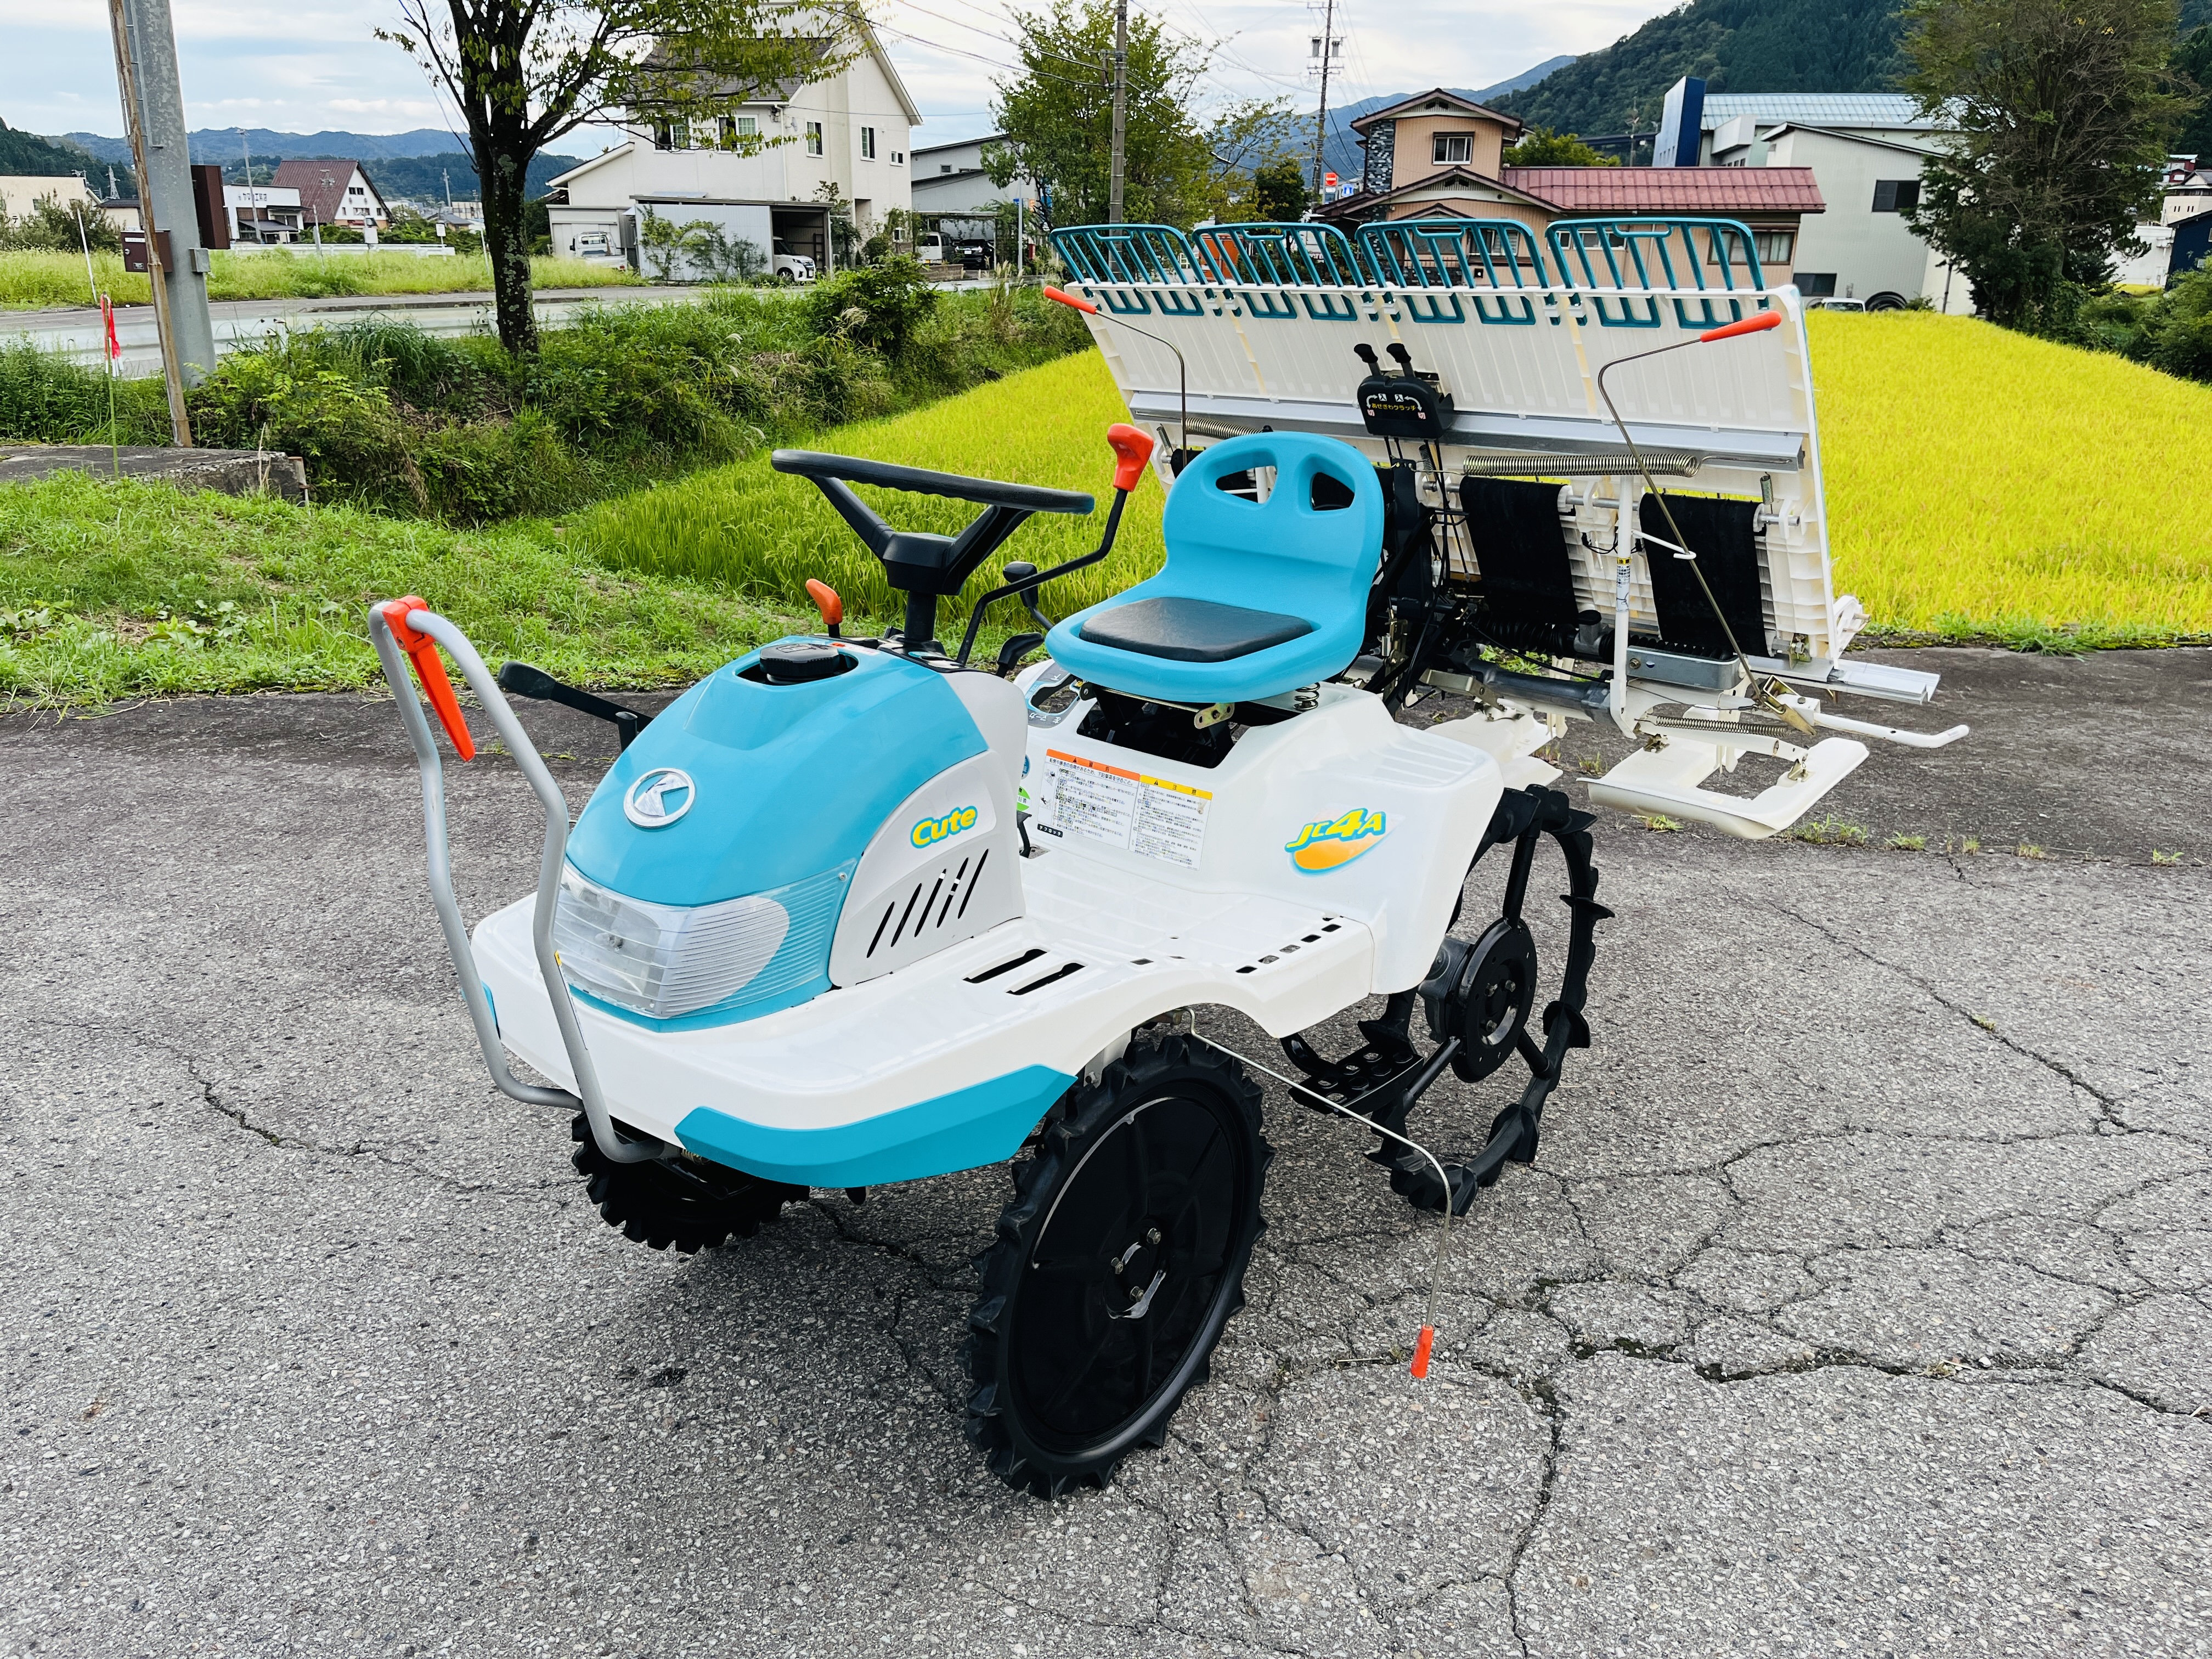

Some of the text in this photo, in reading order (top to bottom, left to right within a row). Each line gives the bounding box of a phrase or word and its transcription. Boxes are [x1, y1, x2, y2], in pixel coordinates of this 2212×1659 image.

[1172, 785, 1197, 795] 注意
[912, 808, 977, 847] Cute
[1285, 808, 1385, 851] JC4A
